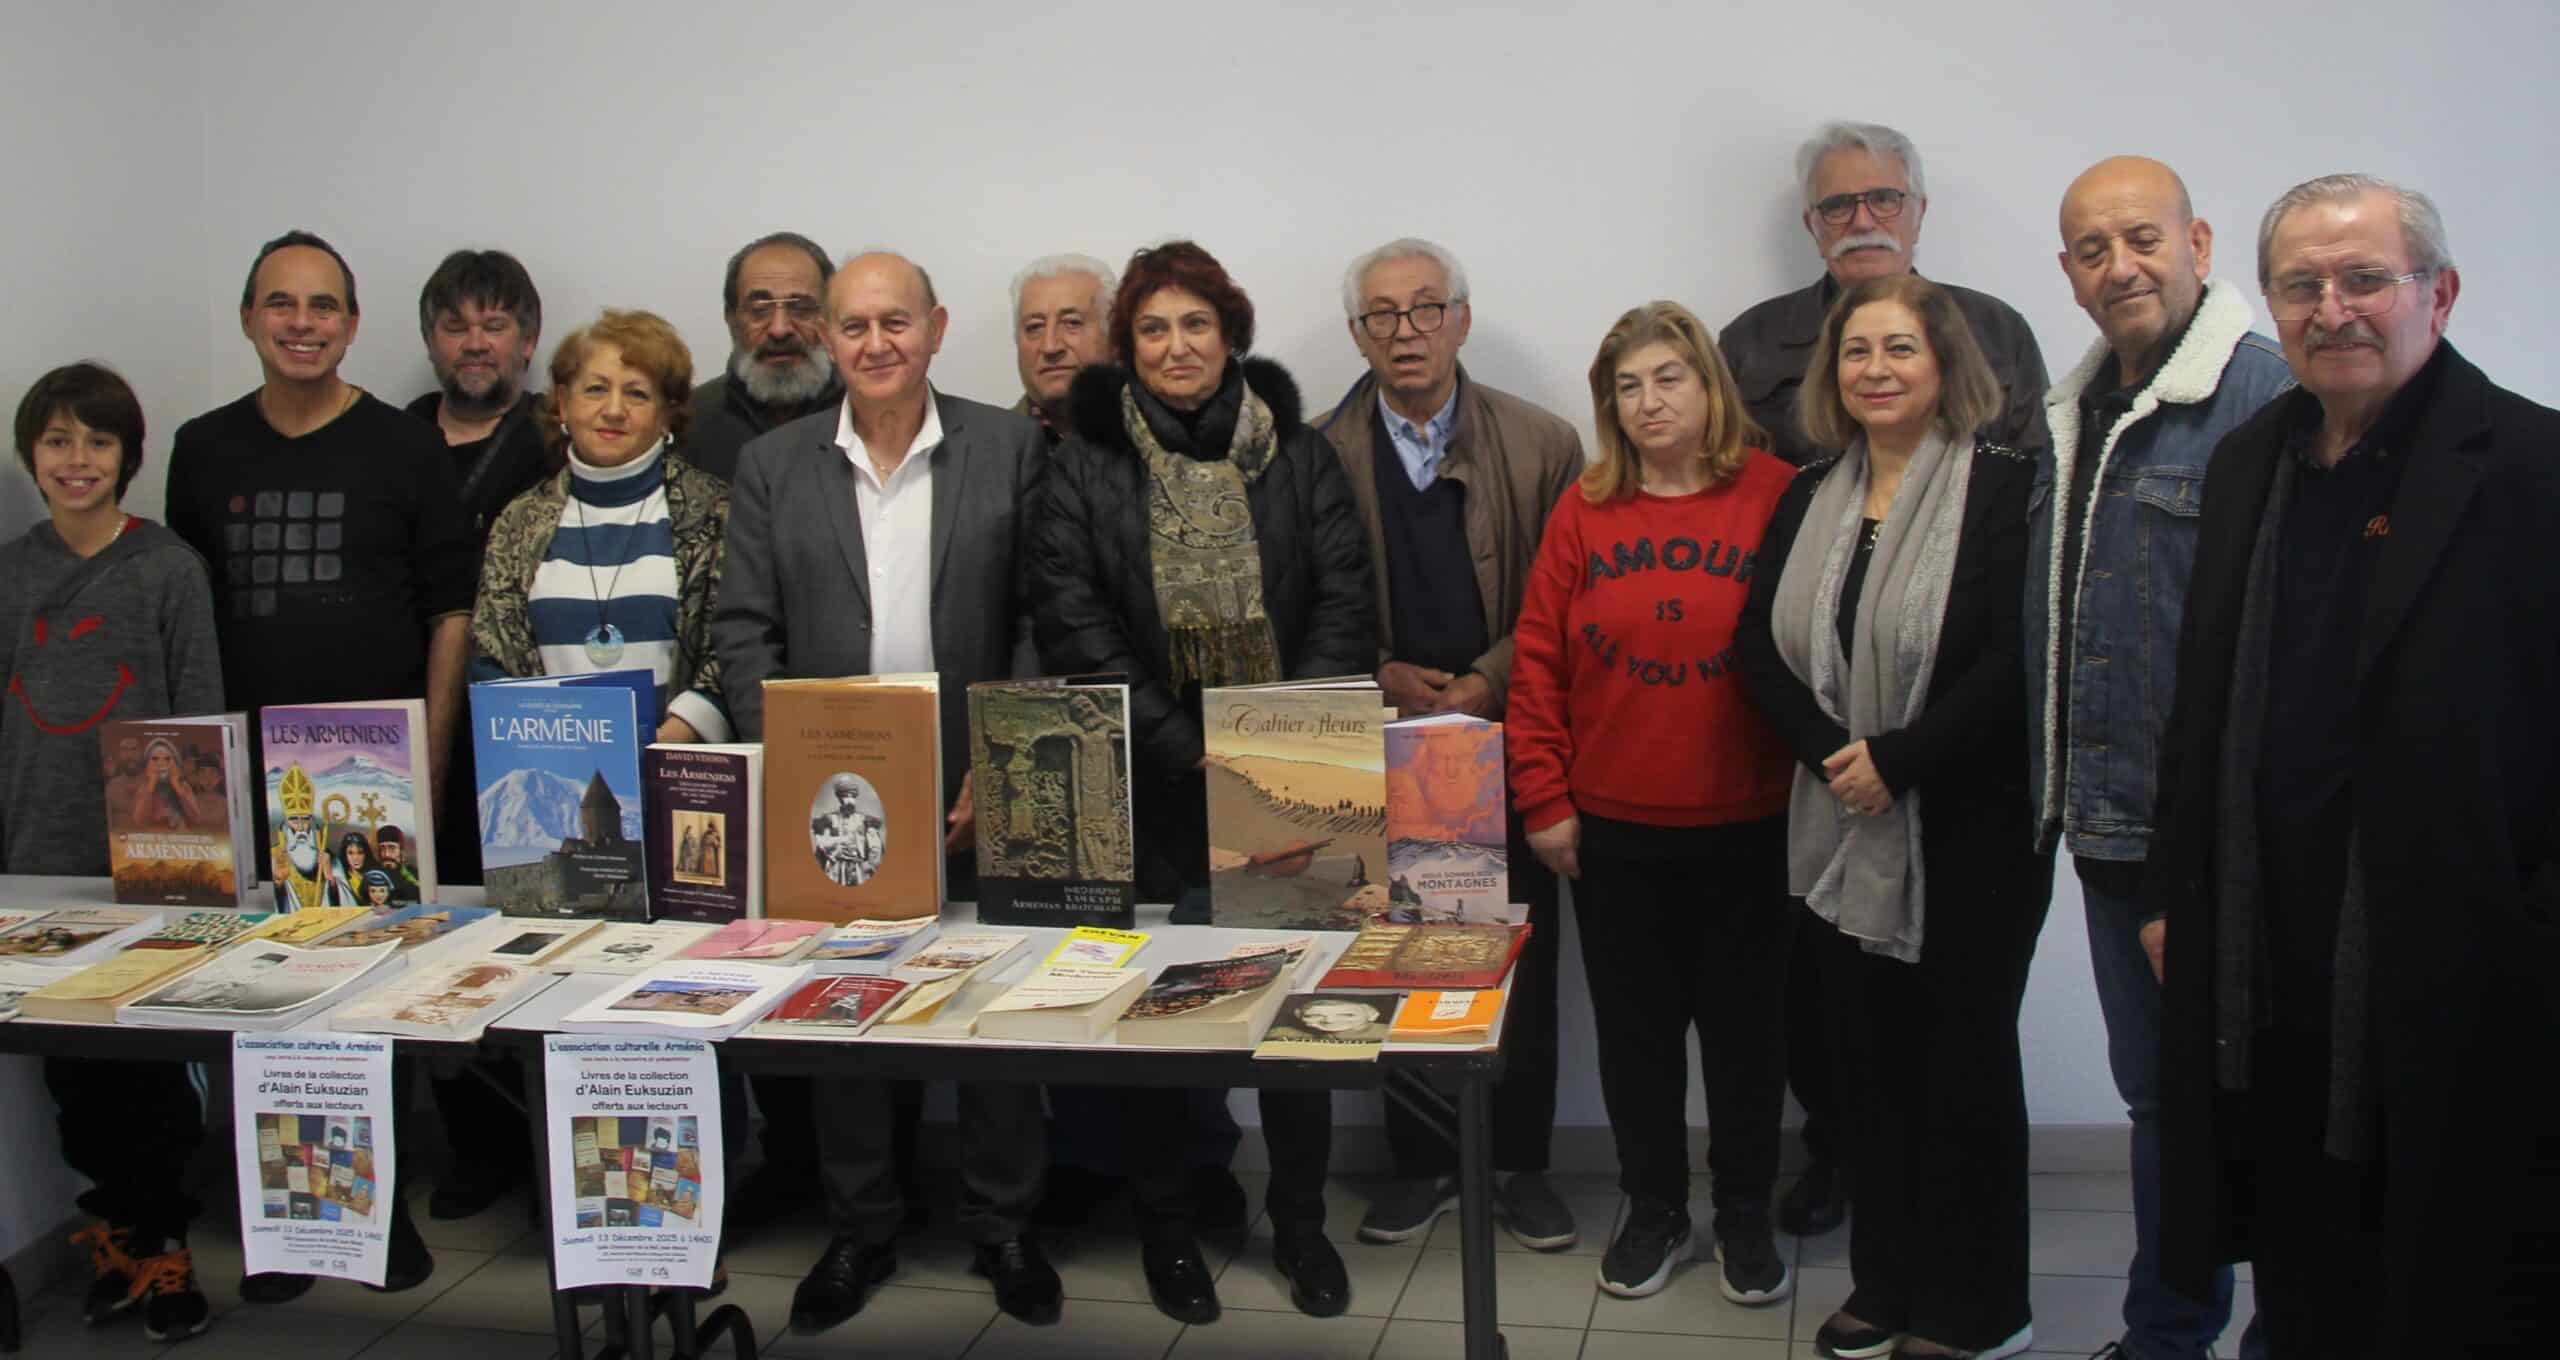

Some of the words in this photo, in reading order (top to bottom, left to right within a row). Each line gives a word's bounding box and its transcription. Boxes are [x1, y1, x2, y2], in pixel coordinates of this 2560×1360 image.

[1656, 598, 1683, 621] IS
[1626, 655, 1687, 687] YOU
[490, 713, 614, 743] L'ARMÉNIE
[1313, 712, 1367, 739] fleurs
[271, 724, 299, 744] LES
[304, 724, 400, 745] ARMENIENS
[665, 752, 694, 761] DAVID
[1418, 878, 1497, 889] MONTAGNES
[264, 1070, 292, 1079] Livres
[294, 1070, 306, 1079] de
[308, 1071, 317, 1079] la
[319, 1071, 366, 1080] collection
[581, 1071, 611, 1080] Livres
[613, 1071, 625, 1080] de
[628, 1071, 637, 1080] la
[640, 1071, 688, 1080] collection
[259, 1082, 301, 1094] d'Alain
[305, 1083, 369, 1096] Euksuzian
[576, 1084, 621, 1096] d'Alain
[625, 1084, 693, 1096] Euksuzian
[274, 1100, 304, 1109] offerts
[325, 1101, 364, 1110] lecteurs
[592, 1101, 624, 1111] offerts
[647, 1101, 688, 1110] lecteurs
[612, 1234, 653, 1242] Décembre
[656, 1234, 677, 1242] 2025
